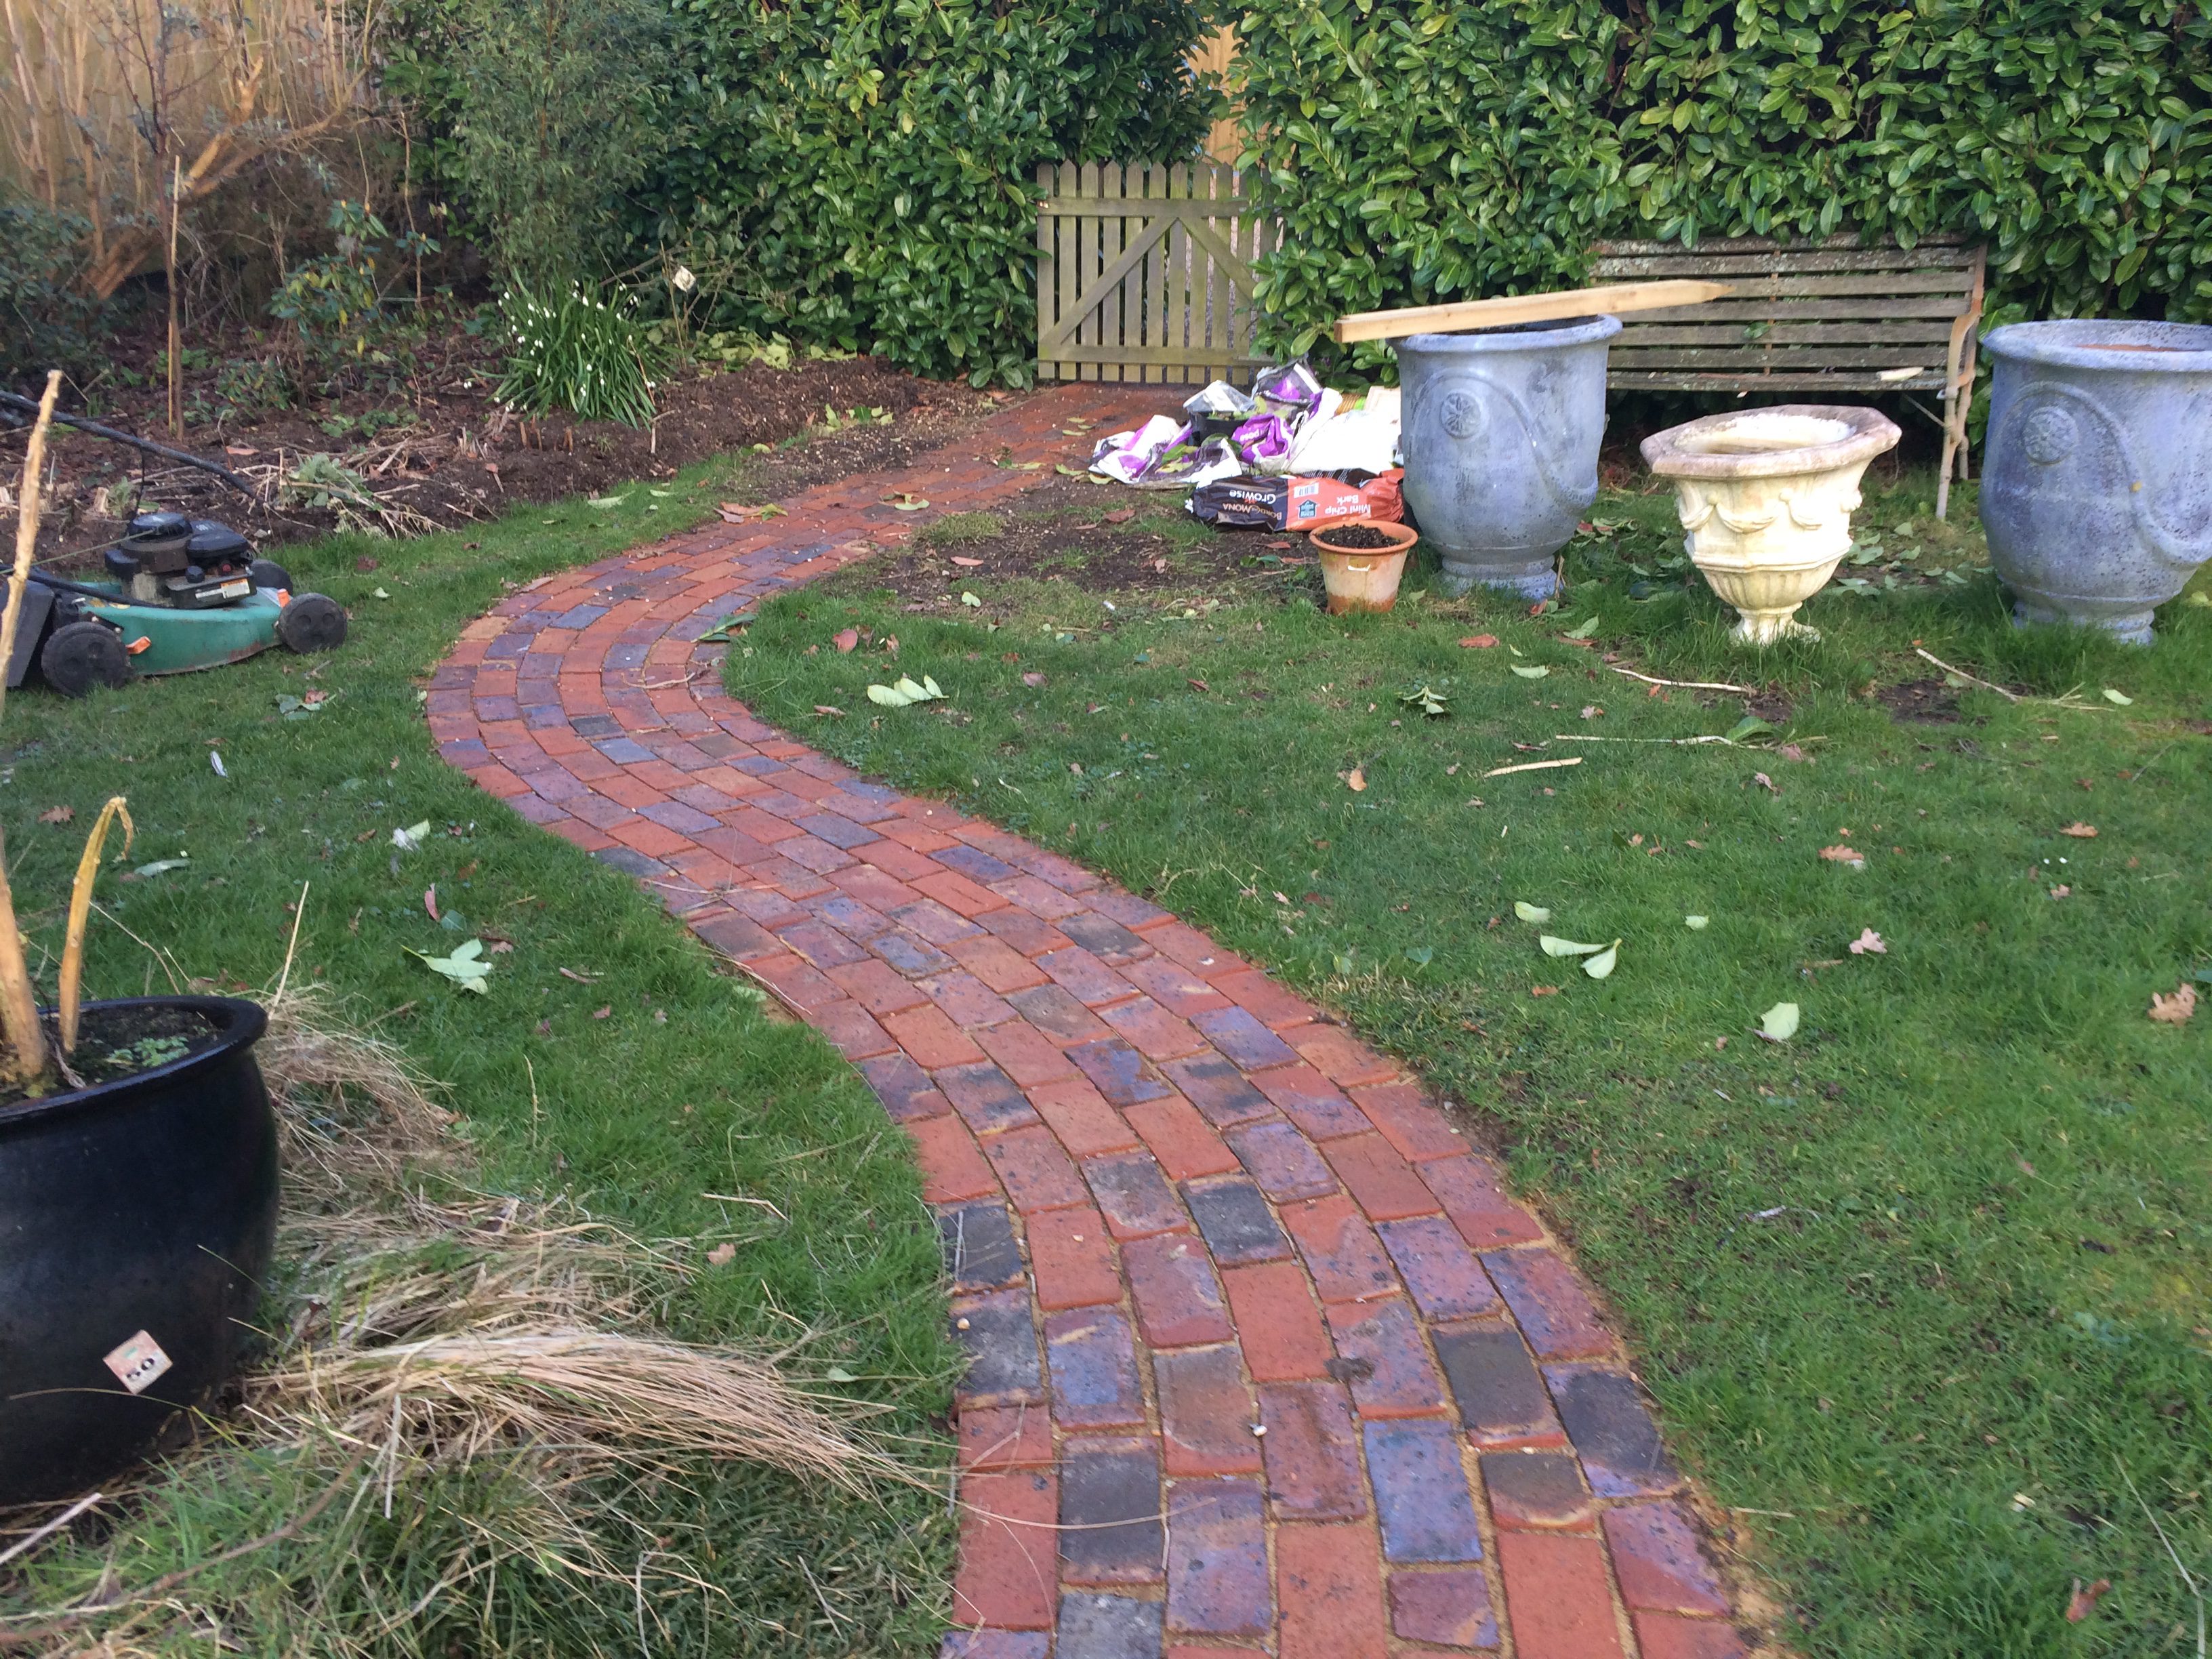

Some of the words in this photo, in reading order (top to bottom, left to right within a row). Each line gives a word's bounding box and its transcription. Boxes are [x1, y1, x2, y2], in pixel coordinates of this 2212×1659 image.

[1336, 495, 1359, 505] Bark
[1325, 506, 1347, 516] Chip
[1349, 504, 1372, 517] Mini
